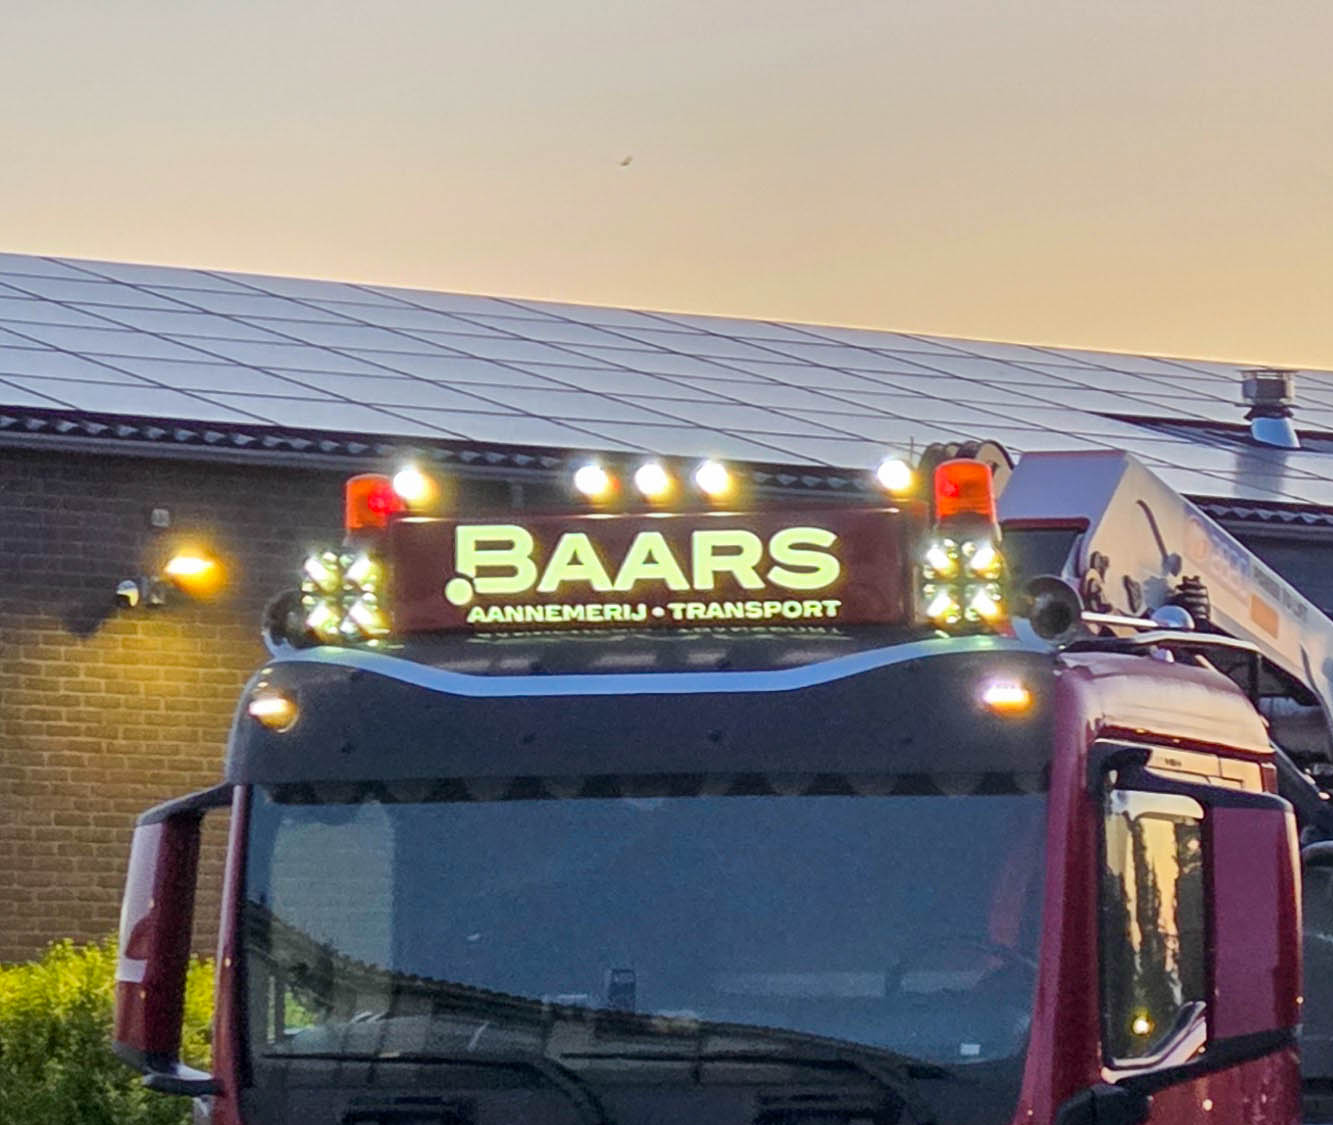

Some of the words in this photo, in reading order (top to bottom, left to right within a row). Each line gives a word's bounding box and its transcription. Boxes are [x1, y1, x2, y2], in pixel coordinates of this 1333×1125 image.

[454, 524, 841, 595] BAARS
[466, 603, 647, 623] AANNEMERIJ
[667, 600, 842, 620] TRANSPORT
